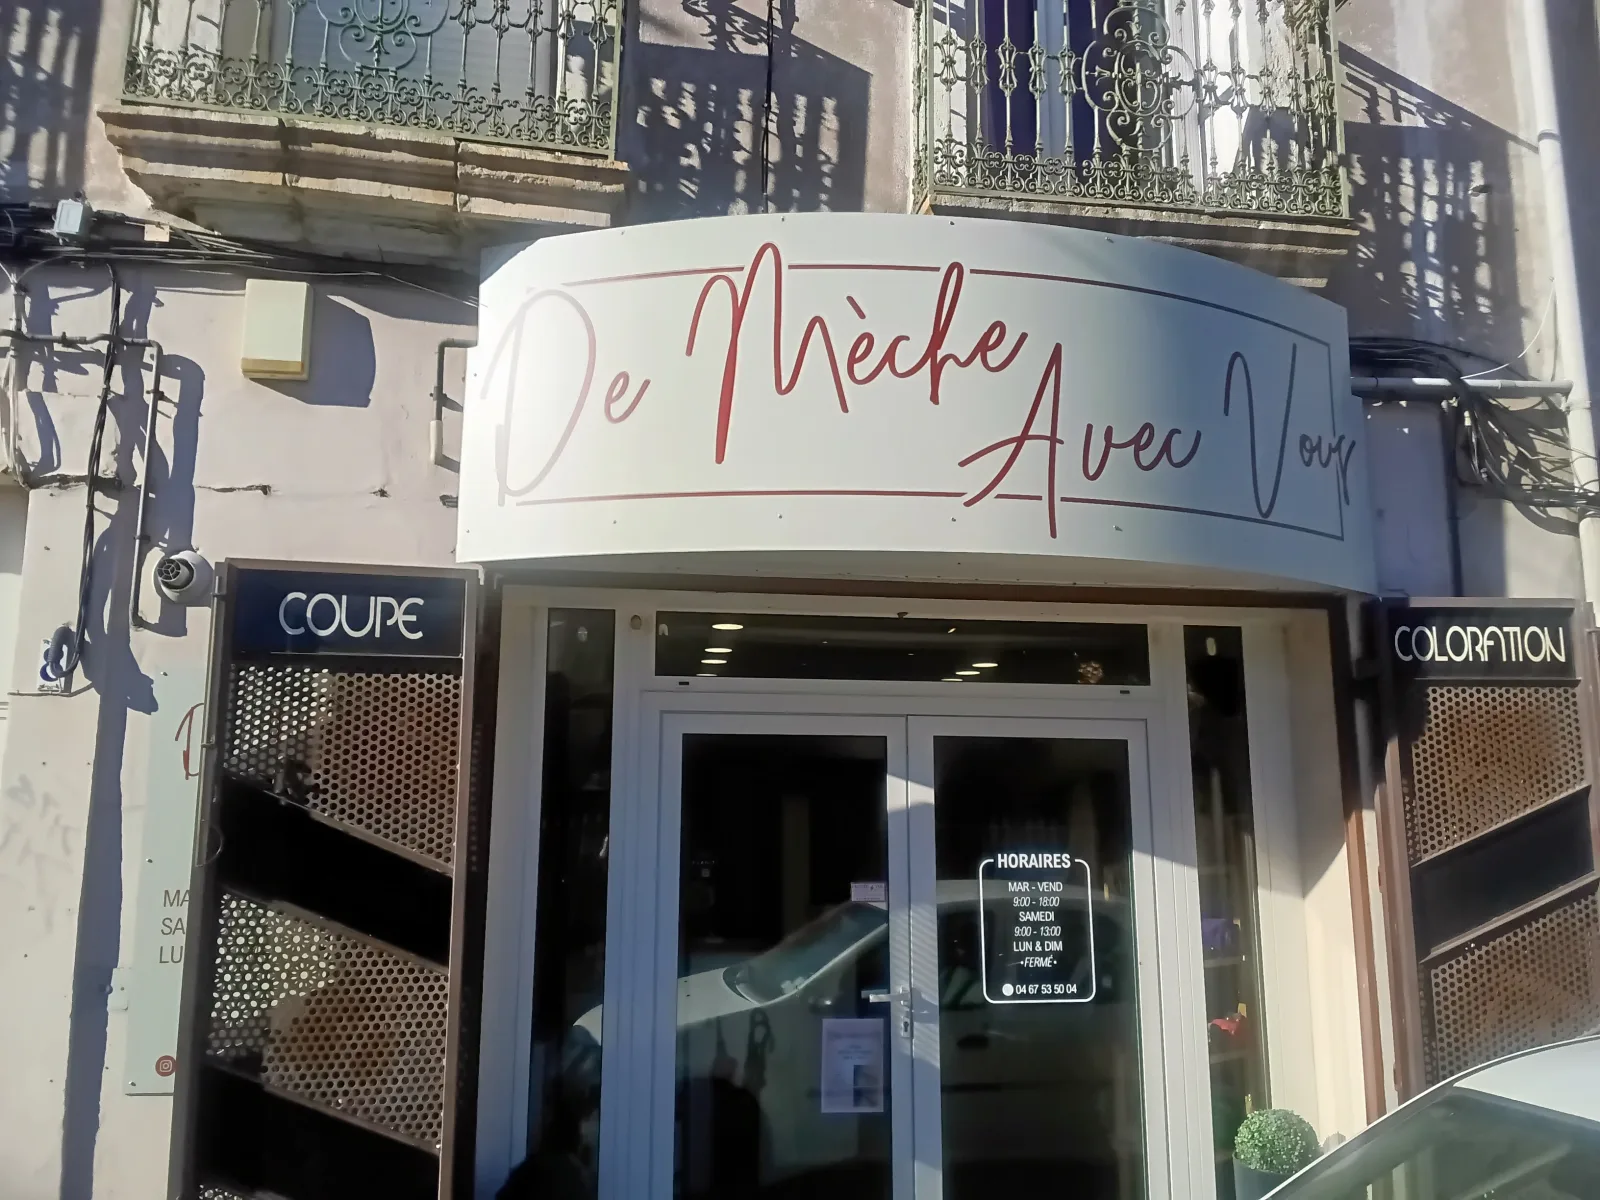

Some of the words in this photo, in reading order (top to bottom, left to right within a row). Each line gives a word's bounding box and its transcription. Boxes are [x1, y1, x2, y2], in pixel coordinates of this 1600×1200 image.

[480, 288, 651, 507] De
[685, 242, 1028, 464] Mèche
[957, 342, 1202, 540] Avec
[278, 591, 425, 640] COUPE
[1394, 625, 1566, 663] COLORATION
[997, 853, 1071, 869] HORAIRES
[1008, 881, 1030, 892] MAR
[1037, 881, 1063, 892] VEND
[1013, 896, 1031, 907] 9:00
[1038, 896, 1060, 907] 18:00
[1019, 911, 1055, 922] SAMEDI
[1014, 926, 1032, 937] 9:00
[1040, 926, 1062, 937] 13:00
[1013, 941, 1033, 952] LUN
[1034, 941, 1042, 952] &
[1044, 941, 1063, 952] DIM
[1015, 984, 1027, 995] 04
[1028, 984, 1039, 995] 67
[1041, 984, 1053, 995] 53
[1053, 983, 1065, 994] 50
[1066, 983, 1078, 994] 04
